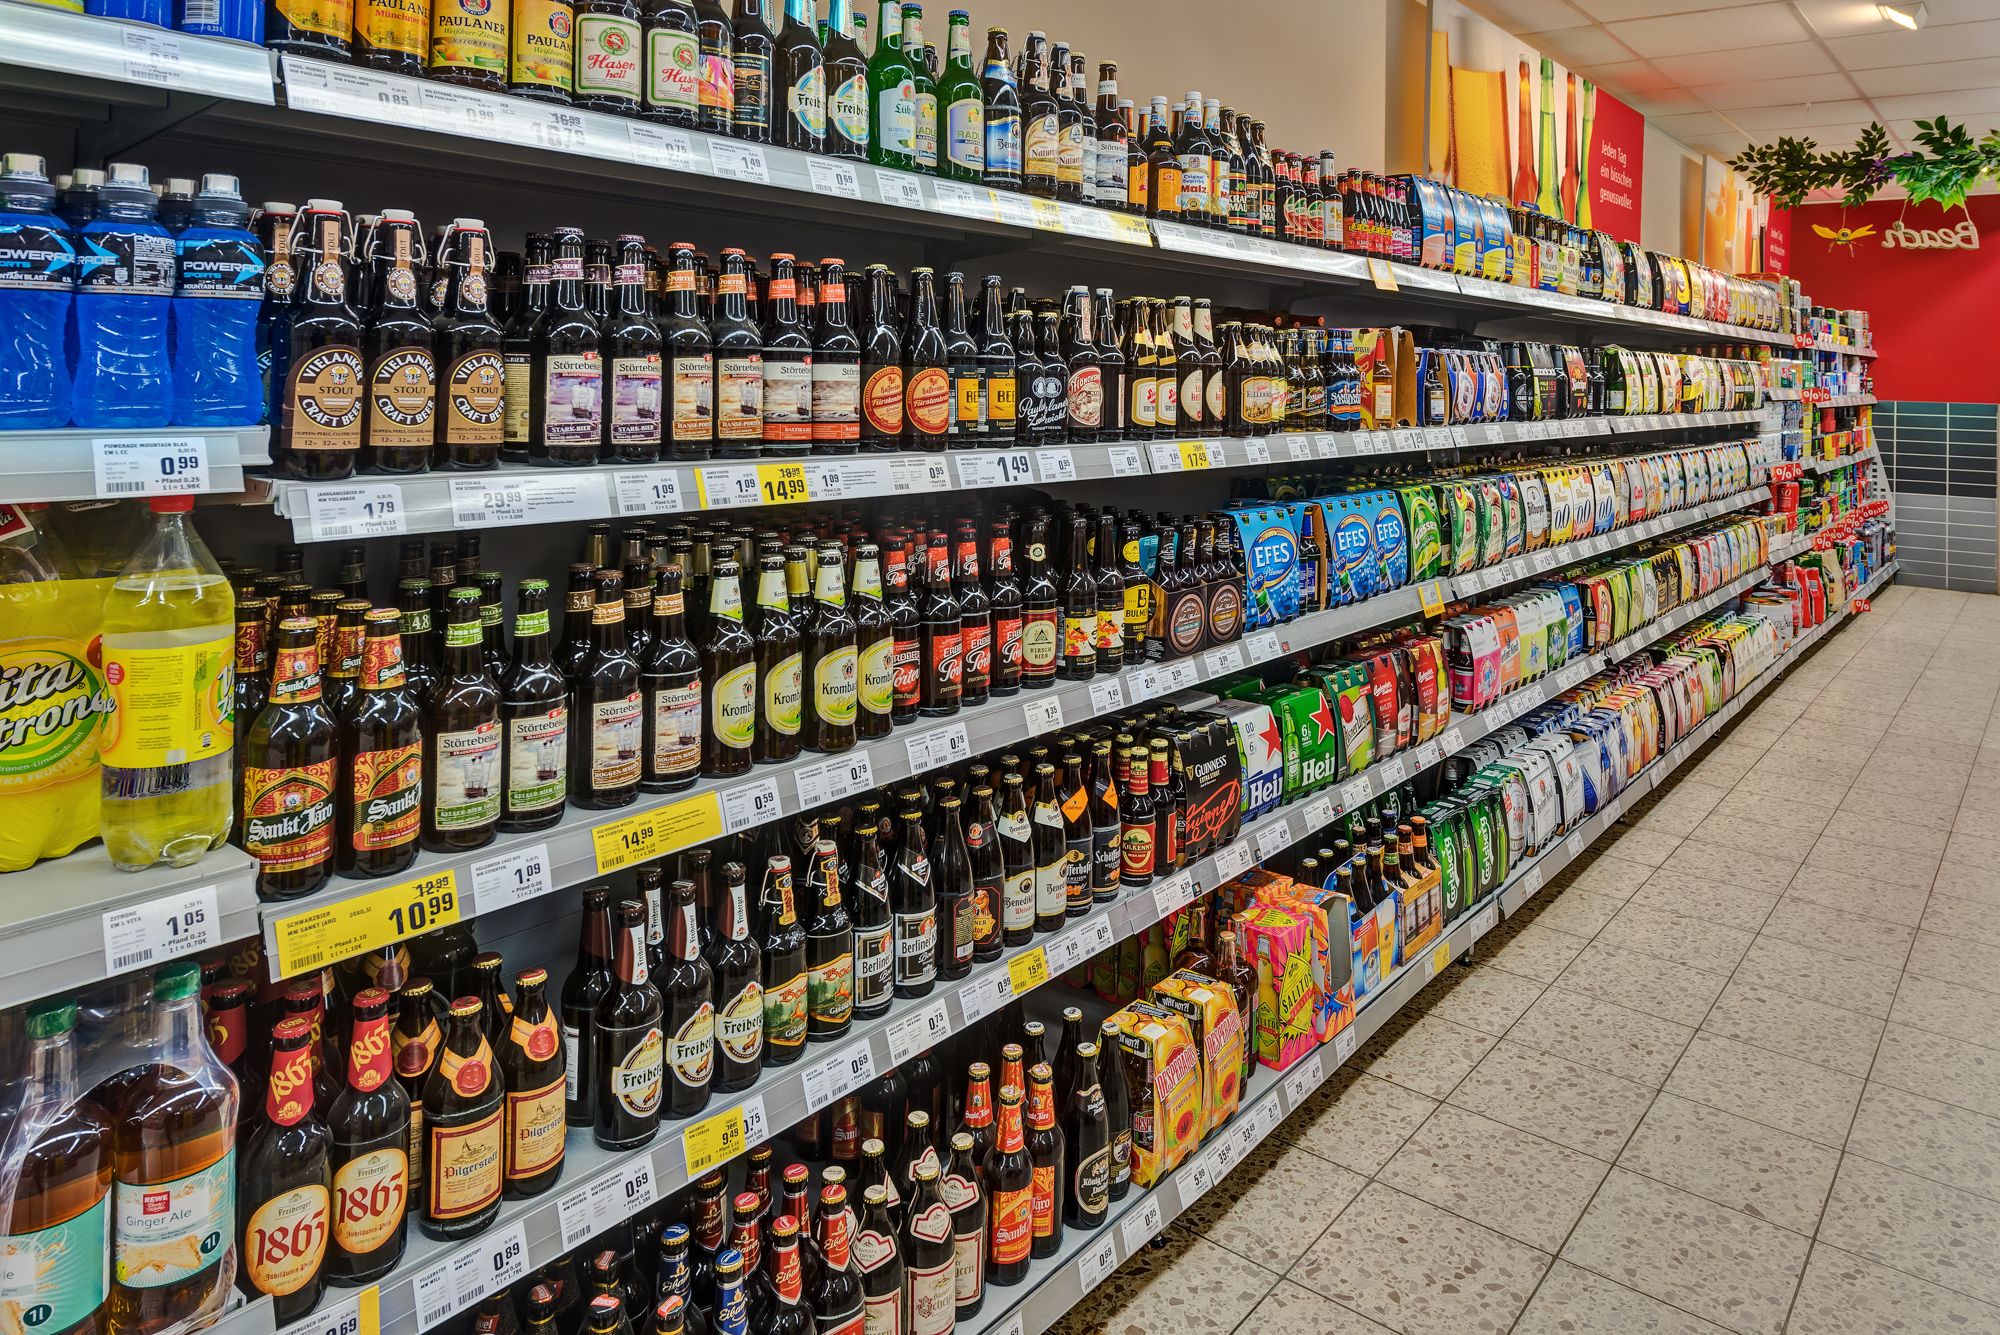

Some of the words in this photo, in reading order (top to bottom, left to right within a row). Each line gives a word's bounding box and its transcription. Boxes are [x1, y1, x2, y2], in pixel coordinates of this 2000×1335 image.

[439, 15, 505, 35] PAULANER
[587, 54, 635, 71] Hasen
[606, 68, 627, 79] hell
[741, 155, 761, 170] 1.49
[1601, 139, 1617, 160] Jeden
[1617, 147, 1628, 168] Tag
[1600, 162, 1609, 179] ein
[1610, 165, 1632, 189] bisschen
[1181, 184, 1207, 193] Malz
[184, 262, 264, 274] POWERADE
[303, 352, 364, 381] VIELANKER
[378, 353, 435, 381] VIELANKER
[319, 386, 353, 395] STOUT
[393, 386, 426, 394] STOUT
[470, 386, 499, 394] STOUT
[301, 398, 340, 427] CRAFT
[342, 401, 362, 426] BEER
[378, 397, 415, 425] CRAFT
[415, 400, 434, 424] BEER
[455, 397, 490, 424] CRAFT
[551, 425, 592, 433] STARK-BIER
[1410, 431, 1423, 448] 1.29
[160, 456, 199, 475] 0.99
[997, 455, 1030, 482] 1.49
[1188, 452, 1207, 467] 17.49
[735, 479, 756, 494] 1.09
[763, 479, 805, 501] 14.99
[821, 474, 840, 489] 1.09
[652, 484, 675, 499] 1.09
[363, 501, 396, 519] 1.79
[1337, 526, 1367, 551] EFES
[1375, 518, 1401, 541] EFES
[1255, 542, 1290, 568] EFES
[1034, 652, 1049, 660] BIER
[276, 680, 304, 694] Sankt
[1044, 706, 1057, 720] 1.35
[950, 735, 965, 751] 0.79
[851, 765, 868, 781] 0.79
[1194, 755, 1227, 779] GUINNESS
[367, 796, 415, 823] Sankt
[754, 792, 774, 810] 0.59
[249, 817, 301, 842] Sankt
[299, 802, 333, 834] Jaro
[621, 827, 654, 848] 14.99
[1122, 842, 1153, 852] KILKENNY
[514, 863, 541, 885] 1.09
[516, 884, 530, 893] Pfand
[530, 881, 542, 889] 0.08
[110, 911, 137, 922] ZITRONE
[287, 911, 331, 928] SCHWARZBIER
[389, 893, 454, 936] 10.99
[738, 895, 746, 927] Freiberger
[166, 909, 205, 936] 1.05
[288, 928, 299, 937] MW
[300, 924, 321, 935] SANKT
[321, 918, 337, 930] JARO
[689, 914, 697, 946] Freiberger
[168, 936, 188, 947] Pfand
[190, 931, 206, 940] 0.25
[335, 937, 352, 949] Pfand
[354, 934, 367, 944] 3.10
[1097, 926, 1109, 940] 0.85
[636, 936, 644, 969] Freiberger
[901, 937, 932, 954] Berliner
[862, 953, 890, 975] Berliner
[928, 1012, 944, 1031] 0.75
[350, 1020, 392, 1070] 1863
[851, 1055, 869, 1074] 0.69
[270, 1050, 313, 1104] 1863
[1156, 1048, 1198, 1102] DESPERADOS
[722, 1128, 739, 1146] 9.49
[357, 1162, 390, 1178] Freiberger
[443, 1150, 499, 1179] Pilgerstoff
[625, 1172, 648, 1198] 0.69
[144, 1193, 169, 1204] REWE
[278, 1199, 312, 1217] Freiberger
[337, 1169, 404, 1229] 1863
[126, 1213, 164, 1229] Ginger
[169, 1208, 192, 1222] Ale
[1144, 1208, 1157, 1226] 0.95
[254, 1206, 325, 1270] 1863
[493, 1242, 520, 1271] 0.89
[1100, 1248, 1111, 1267] 0.69
